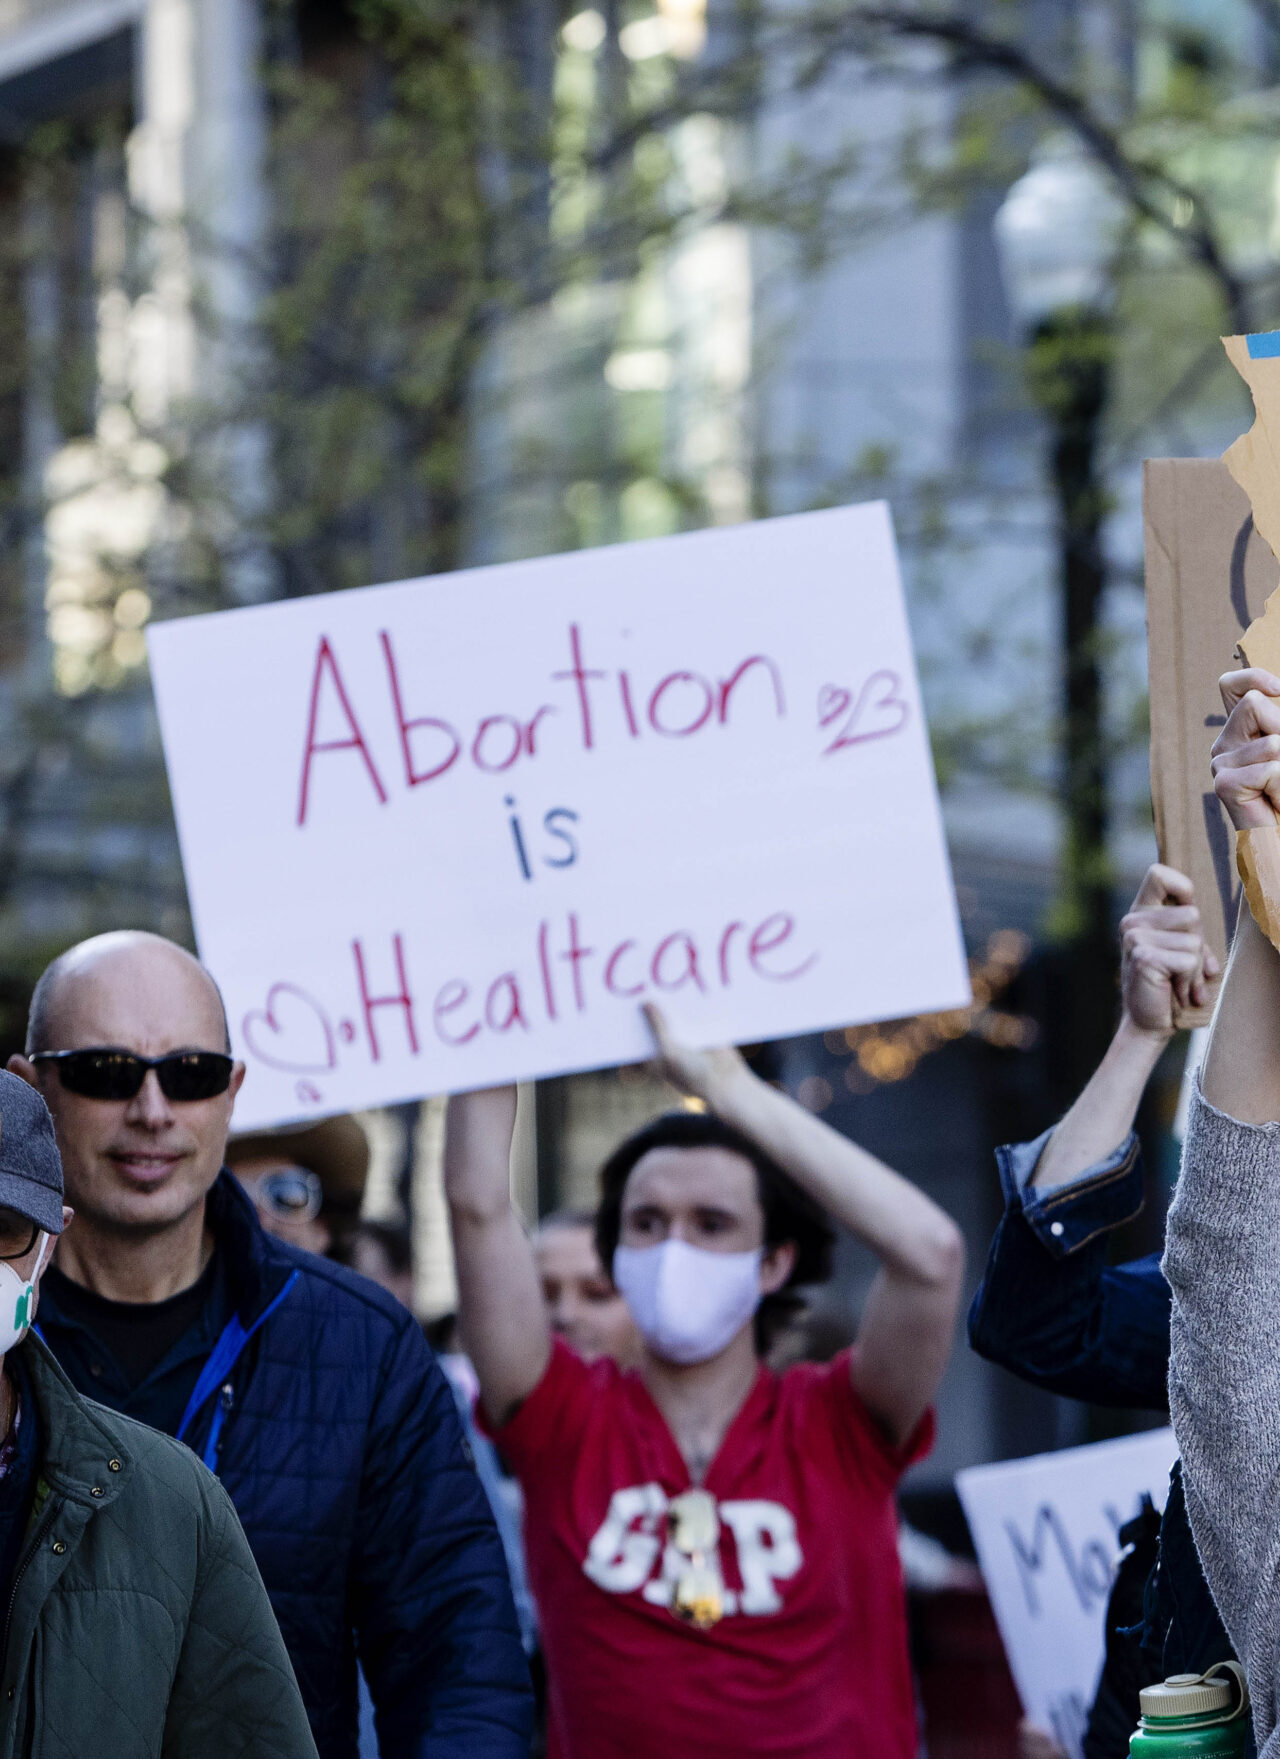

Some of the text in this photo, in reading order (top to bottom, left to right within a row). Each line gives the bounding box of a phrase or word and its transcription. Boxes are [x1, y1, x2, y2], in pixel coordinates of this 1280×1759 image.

[295, 621, 785, 827] Abortion
[503, 795, 581, 881] is
[351, 912, 820, 1062] Healtcare
